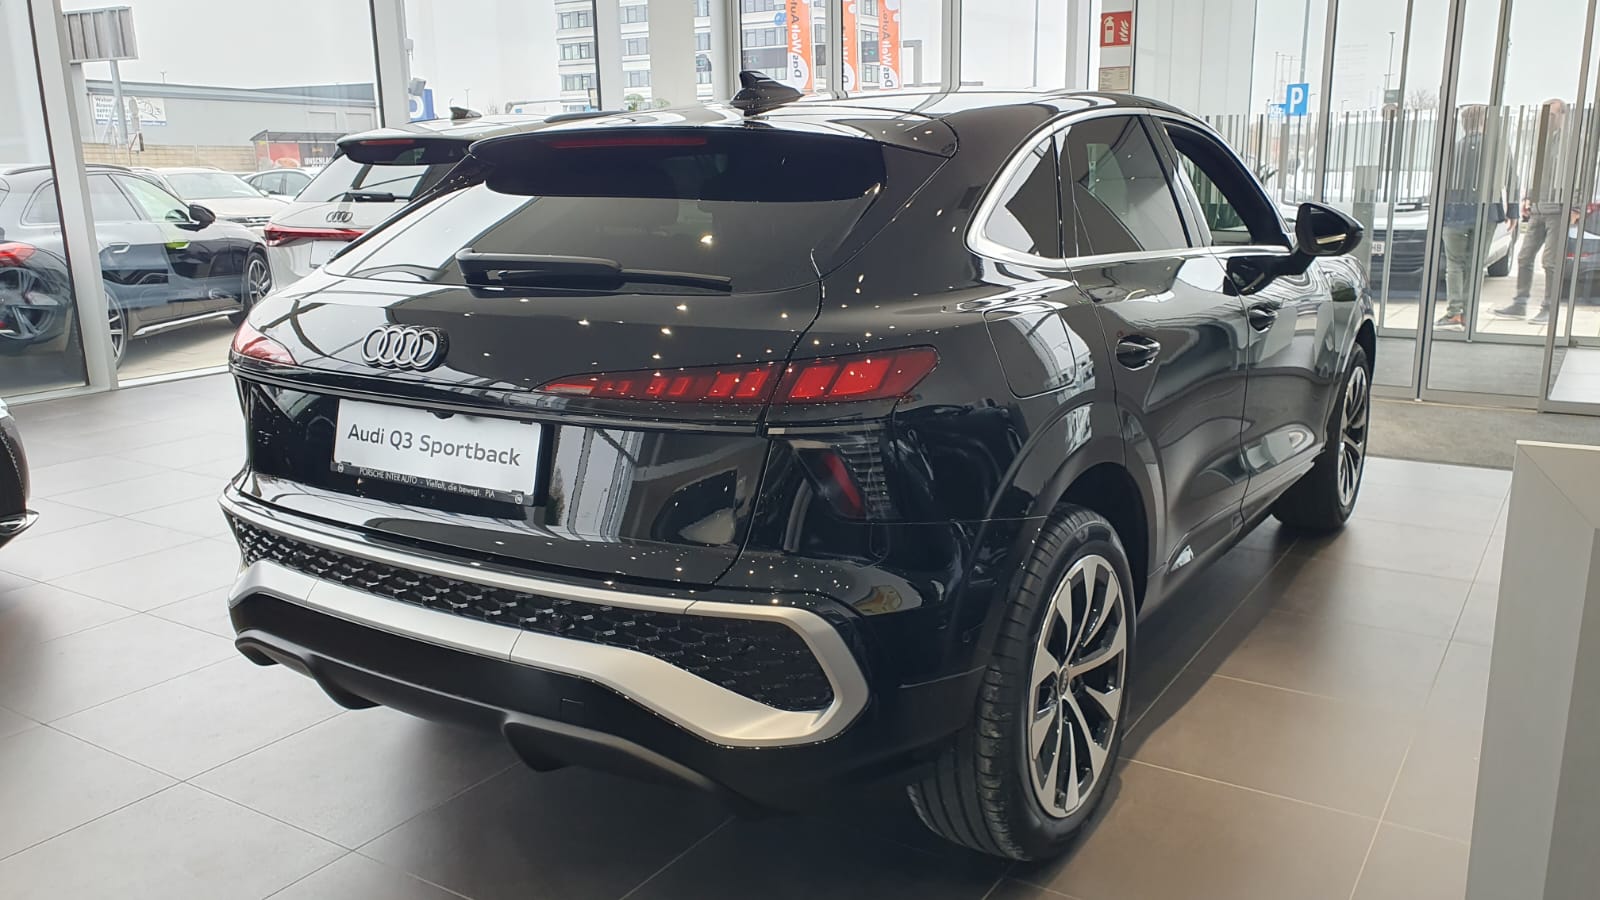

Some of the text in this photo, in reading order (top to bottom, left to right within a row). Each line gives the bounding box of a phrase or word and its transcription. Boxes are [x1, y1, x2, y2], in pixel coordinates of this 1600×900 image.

[1290, 87, 1304, 114] P
[348, 424, 521, 467] Audi Q3 Sportback
[360, 467, 384, 480] PORSCHE
[385, 471, 401, 482] INTER
[401, 474, 418, 485] AUTO
[448, 483, 457, 492] die
